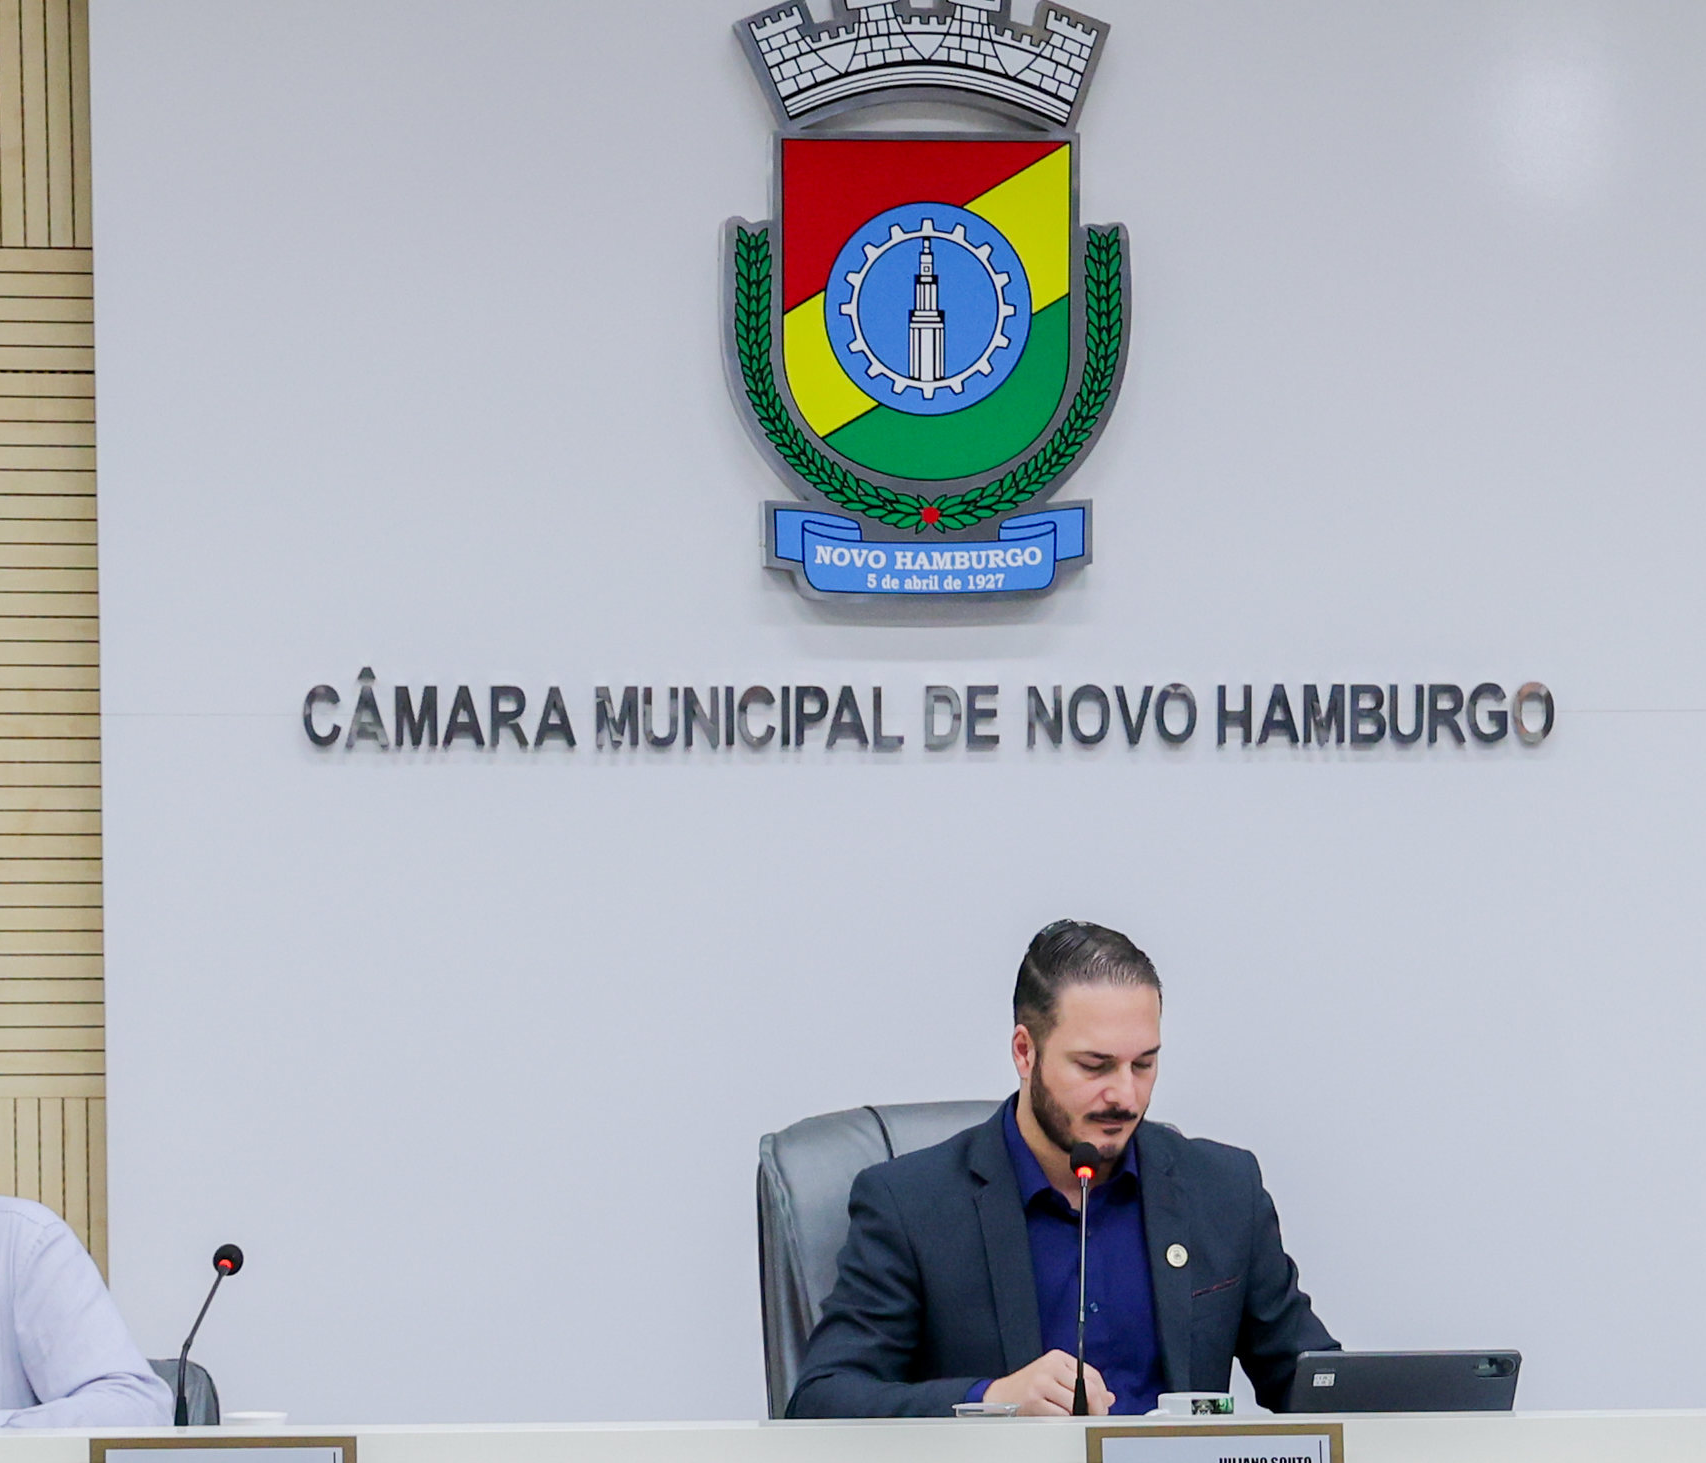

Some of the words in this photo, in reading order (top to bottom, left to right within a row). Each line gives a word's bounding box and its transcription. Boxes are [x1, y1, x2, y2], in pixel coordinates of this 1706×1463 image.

[814, 545, 887, 569] NOVO
[894, 546, 1043, 570] HAMBURGO
[867, 573, 877, 588] 5
[881, 574, 899, 590] de
[904, 574, 940, 590] abril
[943, 574, 962, 590] de
[967, 573, 1005, 590] 1927
[303, 665, 577, 751] CÂMARA
[595, 685, 905, 751] MUNICIPAL
[923, 684, 1000, 748] DE
[1027, 682, 1198, 747] NOVO
[1216, 681, 1556, 747] HAMBURGO
